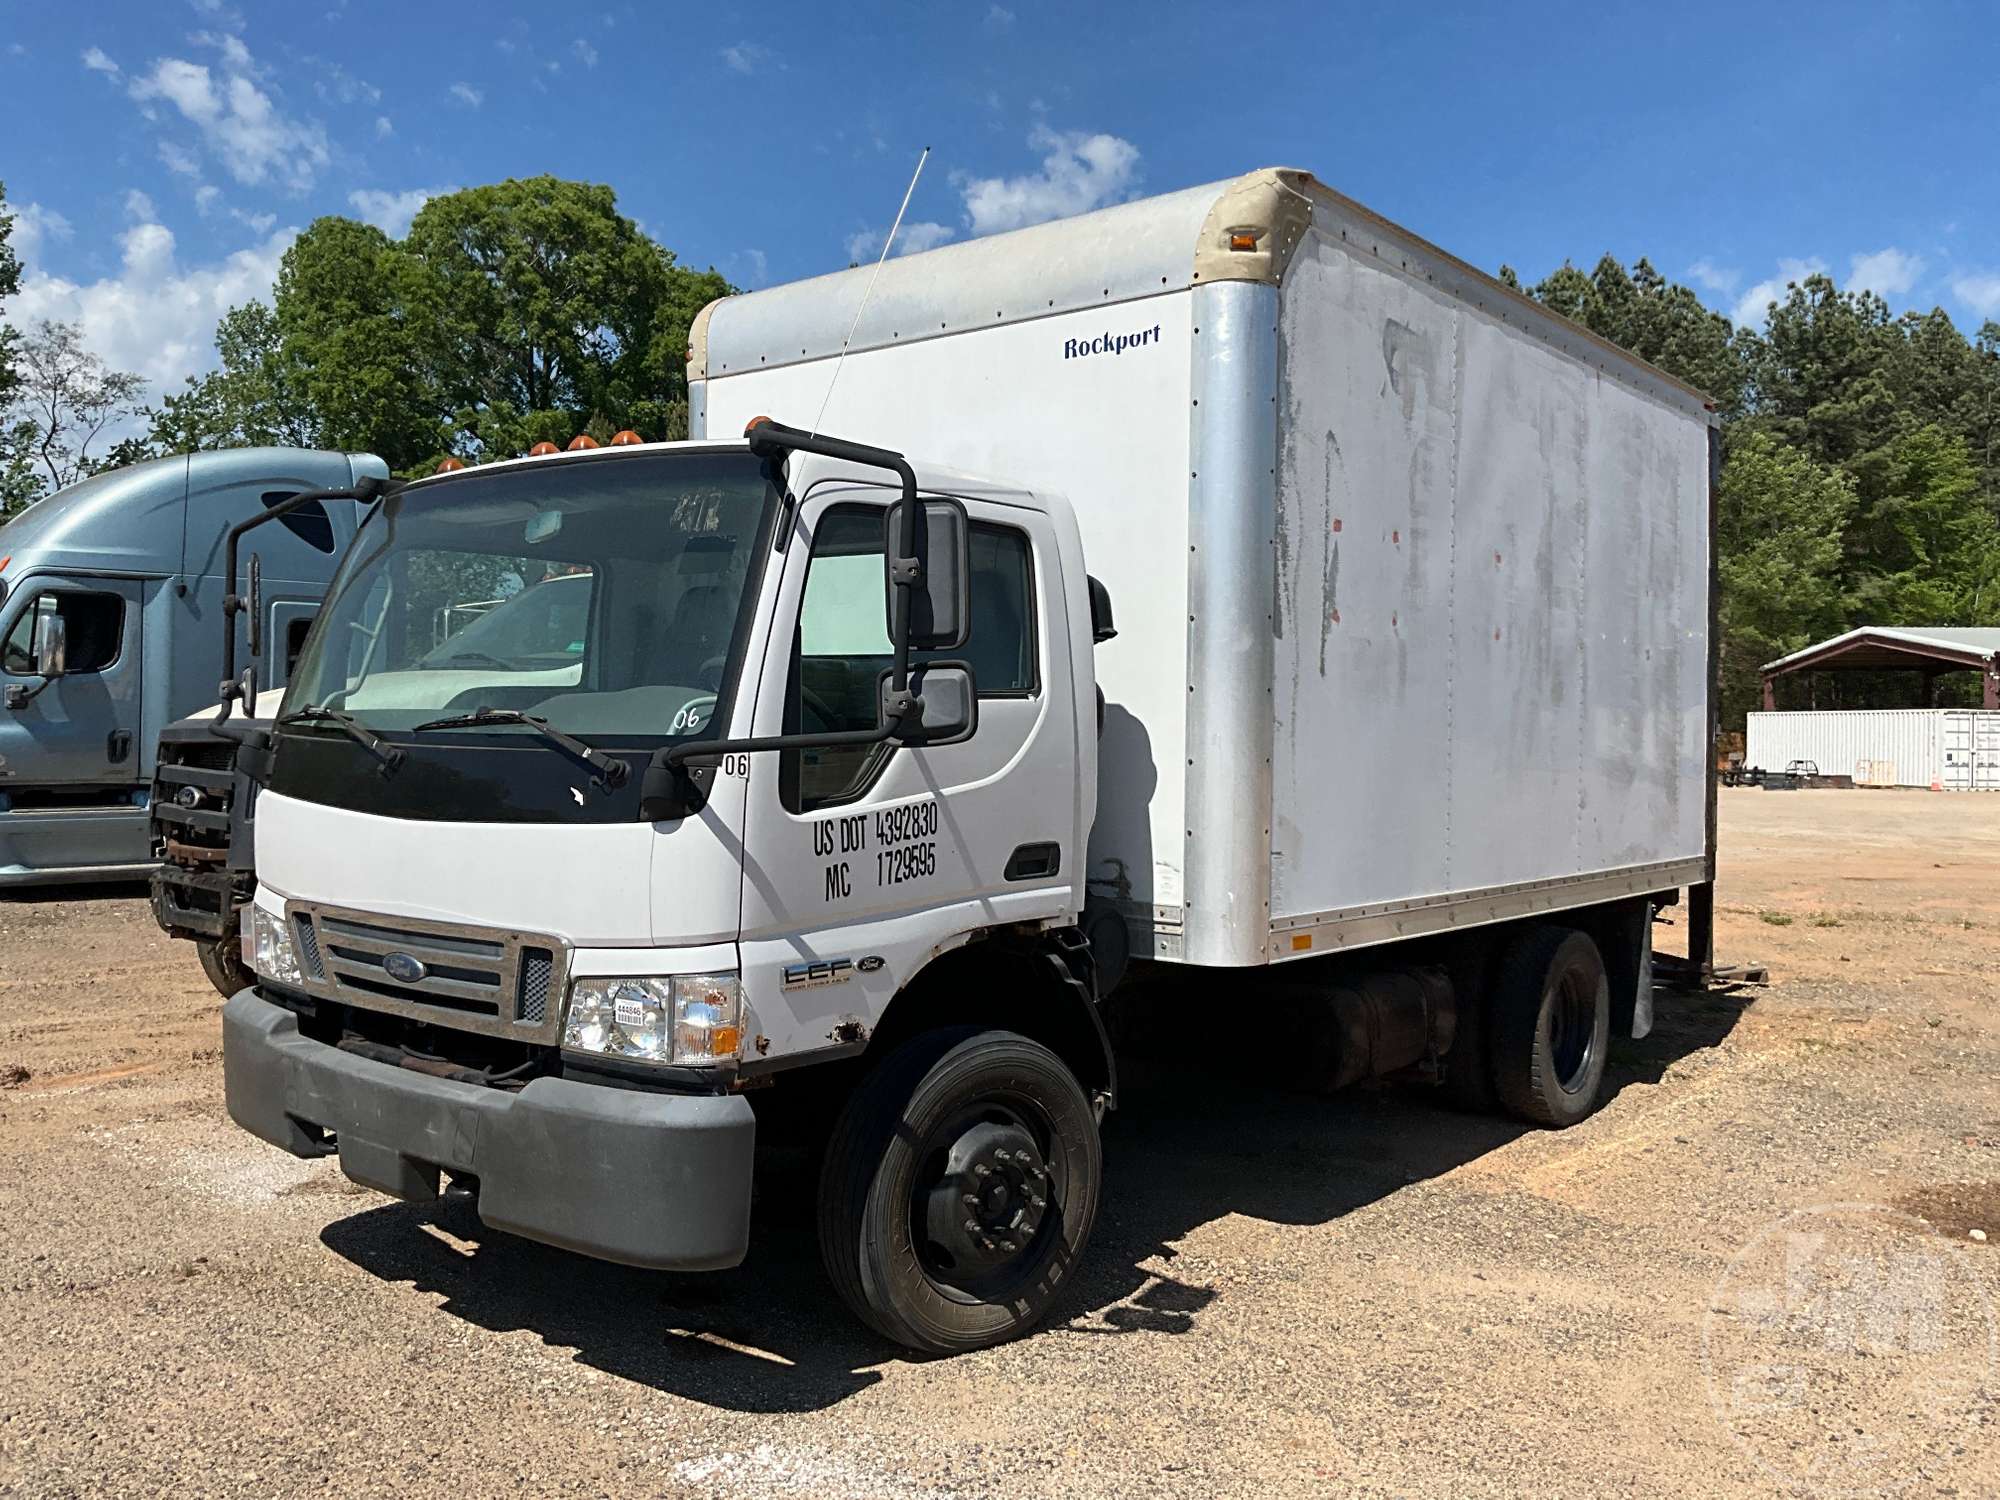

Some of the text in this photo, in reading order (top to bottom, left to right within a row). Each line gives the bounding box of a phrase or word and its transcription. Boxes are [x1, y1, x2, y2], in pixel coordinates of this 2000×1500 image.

[1064, 324, 1161, 359] Rockport
[673, 707, 700, 729] 06
[725, 754, 748, 776] 06
[813, 801, 938, 857] US DOT 4392830
[825, 842, 936, 902] MC 1729595
